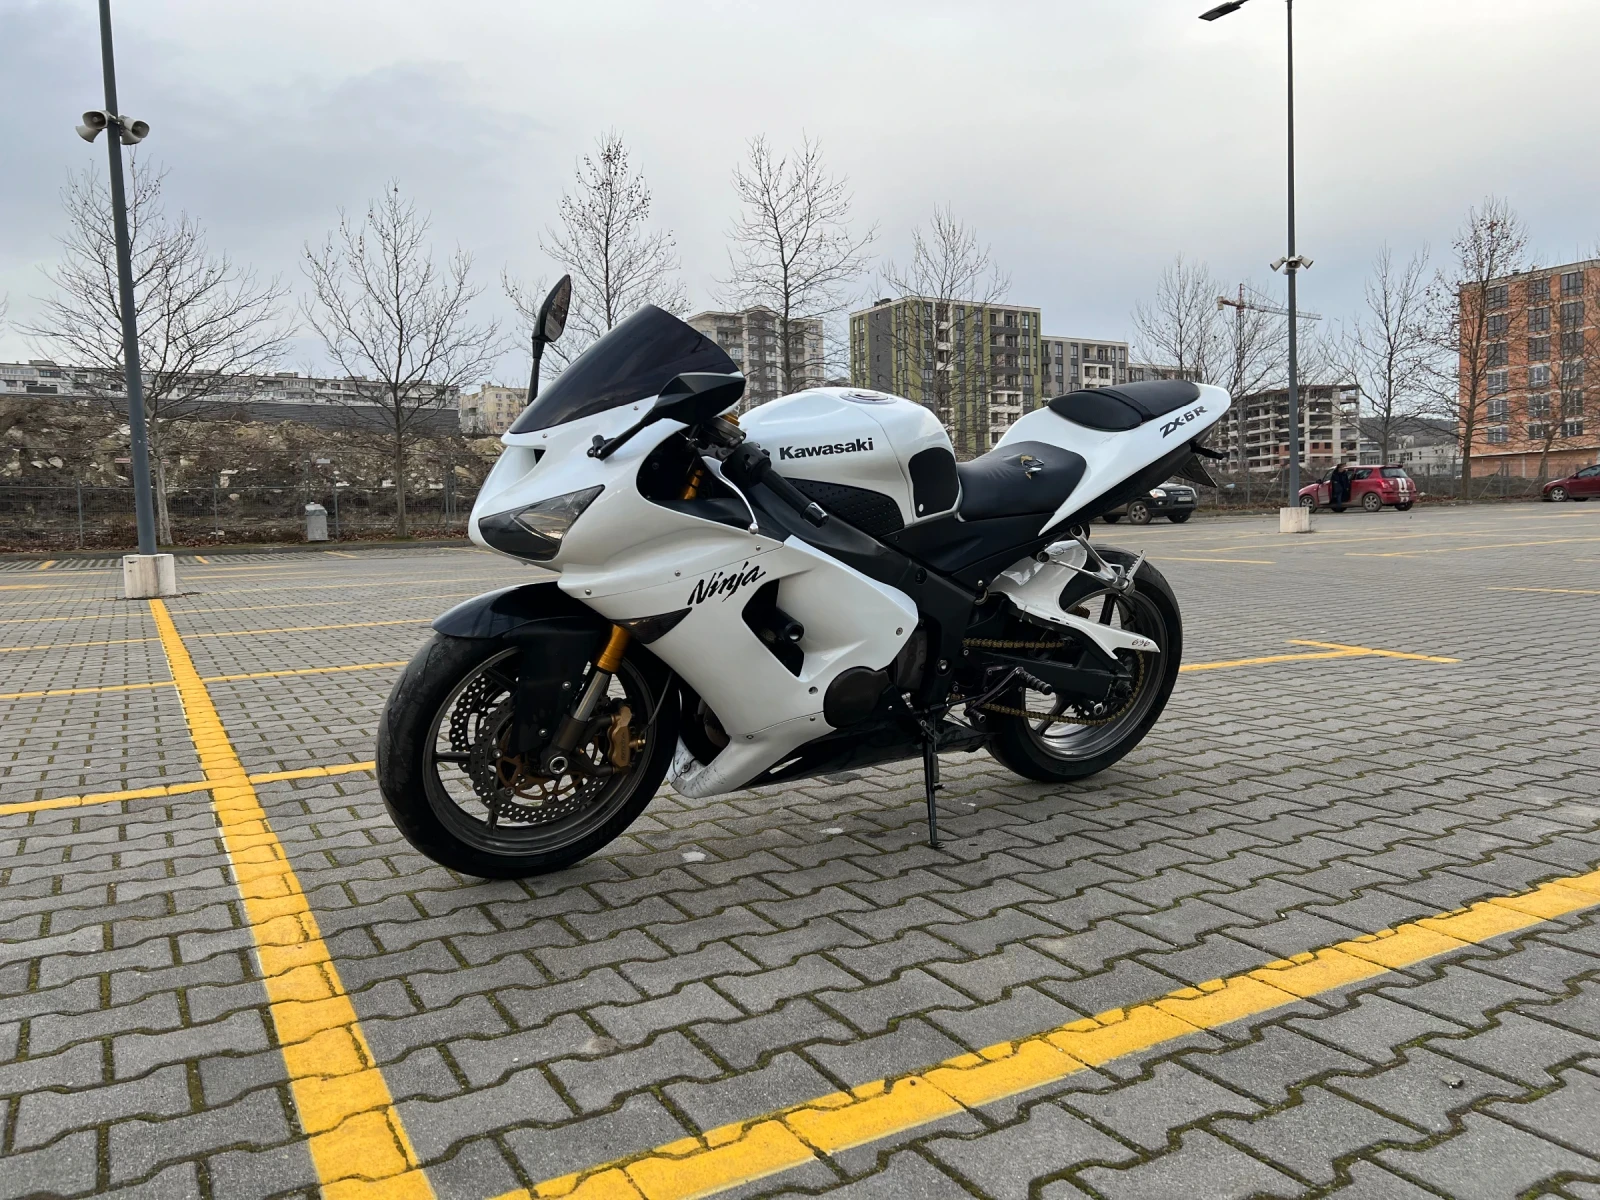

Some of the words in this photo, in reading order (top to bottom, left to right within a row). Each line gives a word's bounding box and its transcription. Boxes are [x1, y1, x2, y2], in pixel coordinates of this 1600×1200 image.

[1160, 405, 1208, 439] ZX-6R
[779, 437, 874, 461] Kawasaki
[687, 560, 767, 606] Ninja
